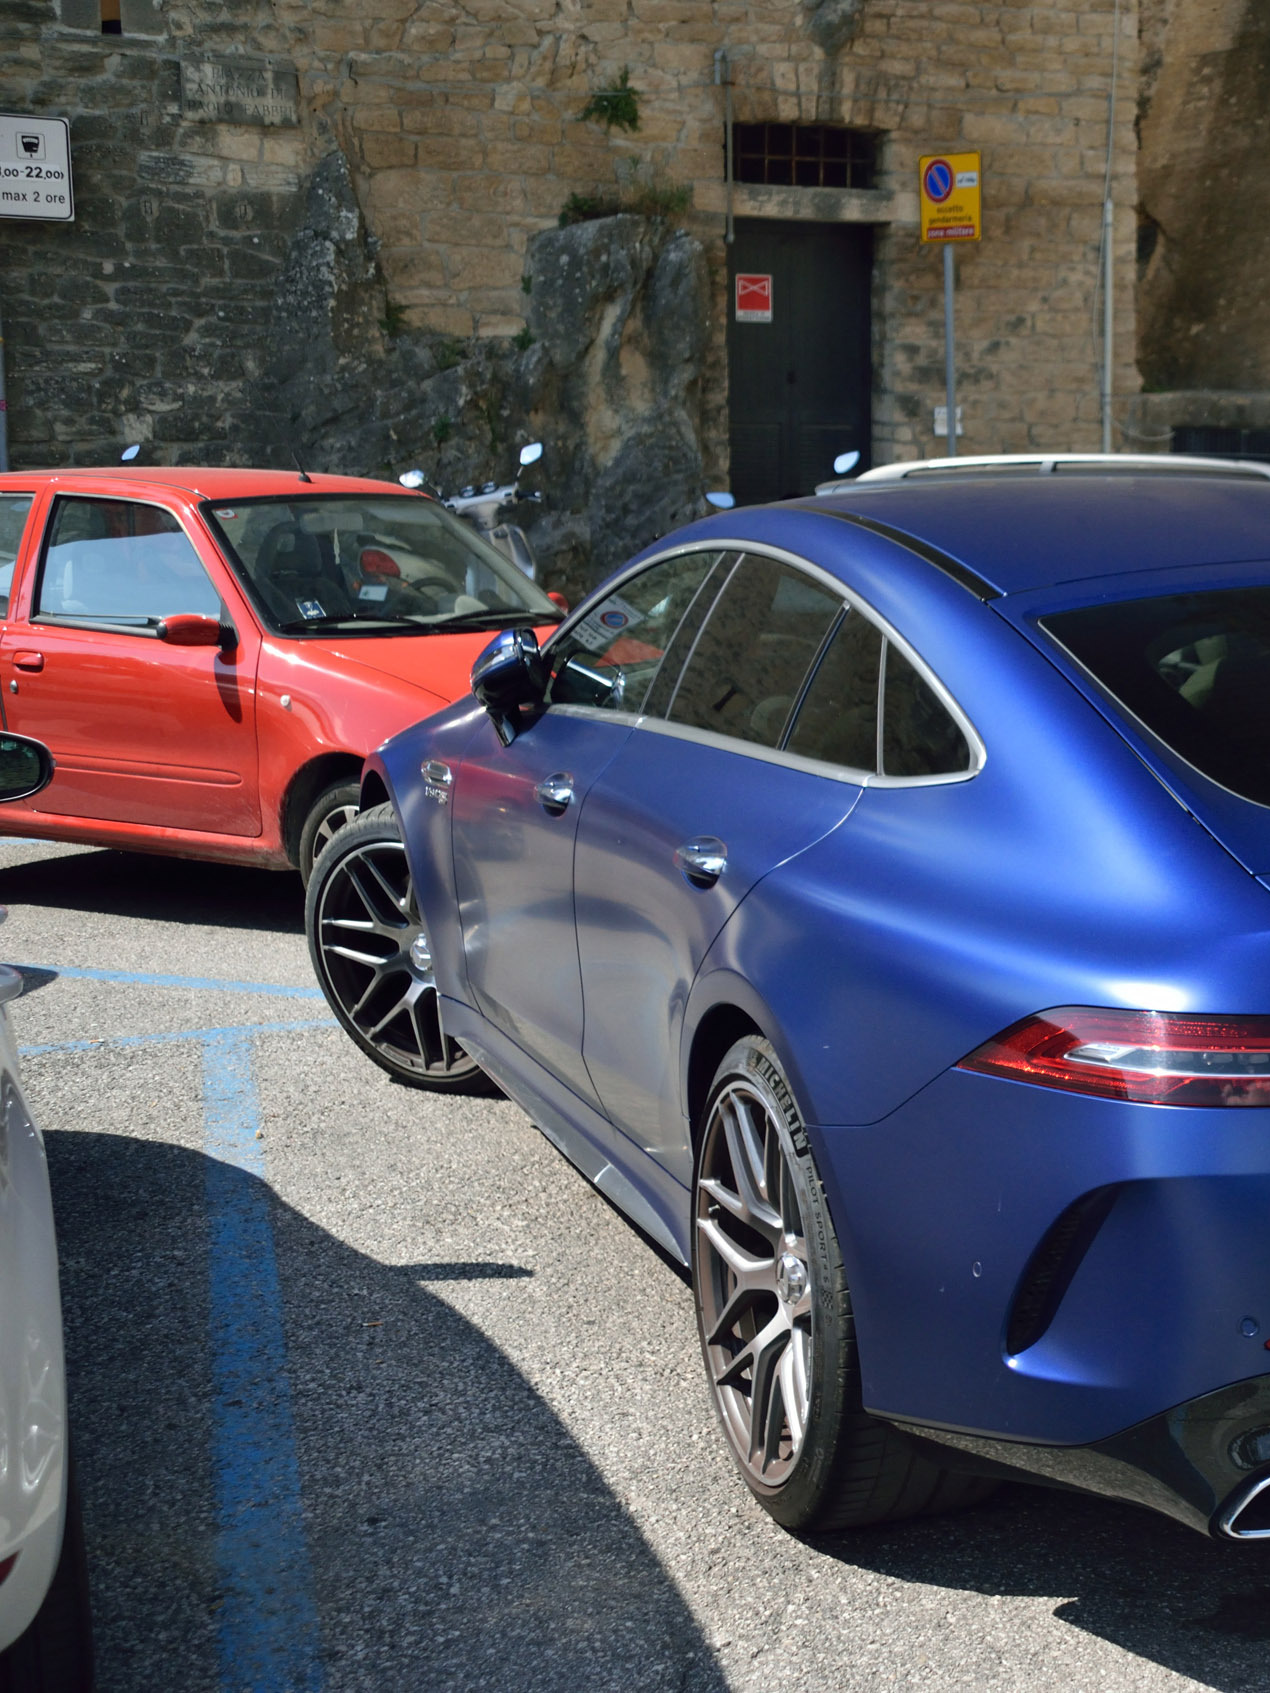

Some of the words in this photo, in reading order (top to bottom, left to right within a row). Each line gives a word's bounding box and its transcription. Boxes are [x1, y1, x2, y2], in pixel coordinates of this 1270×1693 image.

[195, 82, 261, 98] ANTONIO
[271, 87, 285, 100] DI
[185, 99, 234, 115] PAOLO
[2, 191, 28, 202] max
[32, 191, 41, 203] 2
[45, 194, 66, 205] ore
[756, 1056, 809, 1151] MICHELIN
[805, 1166, 820, 1204] PILOT
[814, 1211, 828, 1261] SPORT
